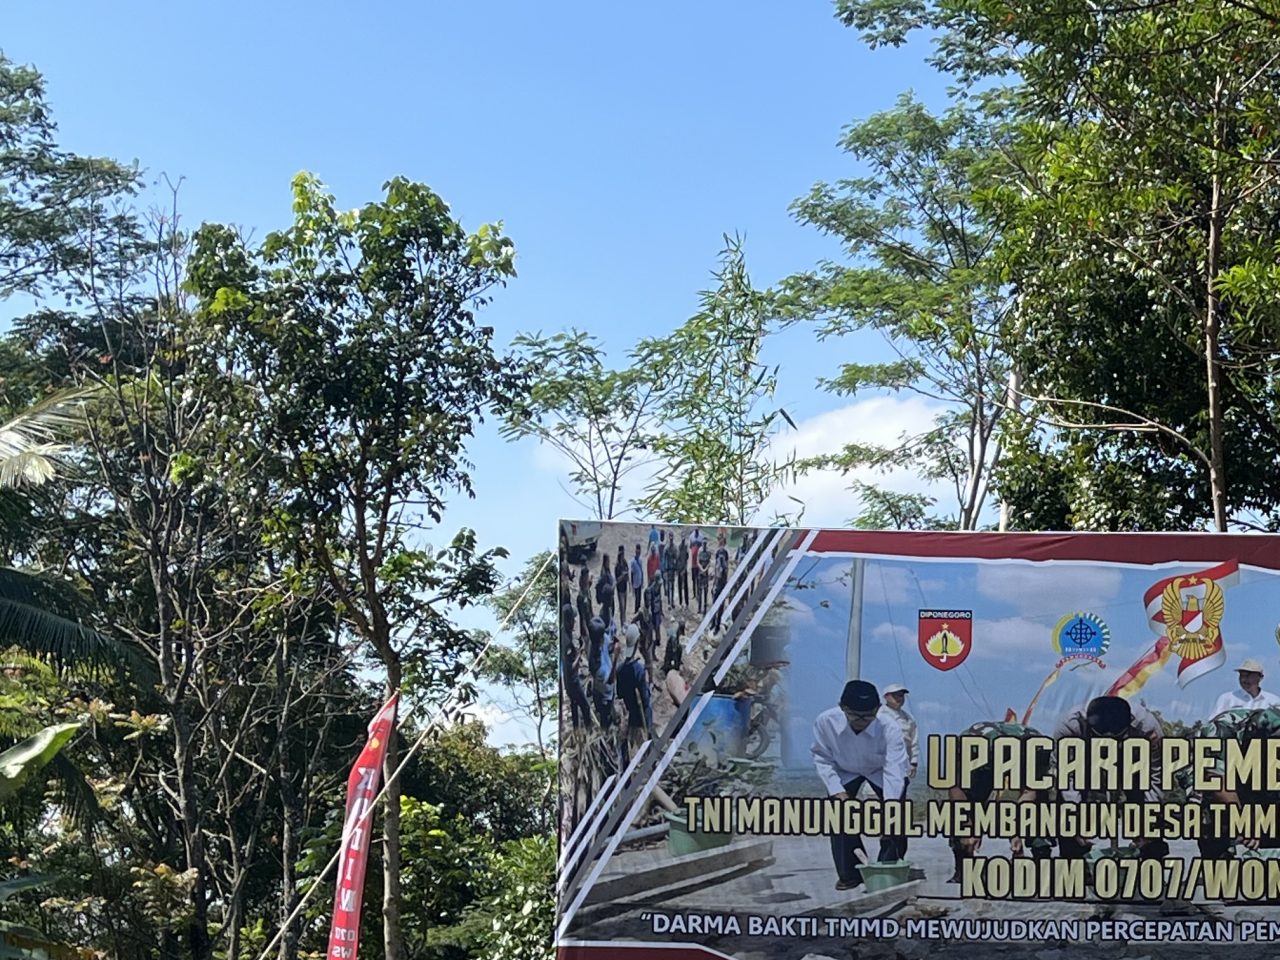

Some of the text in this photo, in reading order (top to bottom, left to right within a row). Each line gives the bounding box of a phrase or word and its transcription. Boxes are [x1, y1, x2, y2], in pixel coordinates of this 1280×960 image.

[920, 611, 972, 619] DIPONEGORO
[927, 736, 1151, 791] UPACARA
[684, 796, 731, 833] TNI
[737, 797, 922, 837] MANUNGGAL
[928, 800, 1117, 838] MEMBANGUN
[1124, 801, 1200, 838] DESA
[961, 857, 1086, 898] KODIM
[749, 916, 817, 937] BAKTI
[824, 917, 899, 938] TMMD
[906, 919, 1079, 940] MEWUJUDKAN
[1086, 920, 1234, 941] PERCEPATAN
